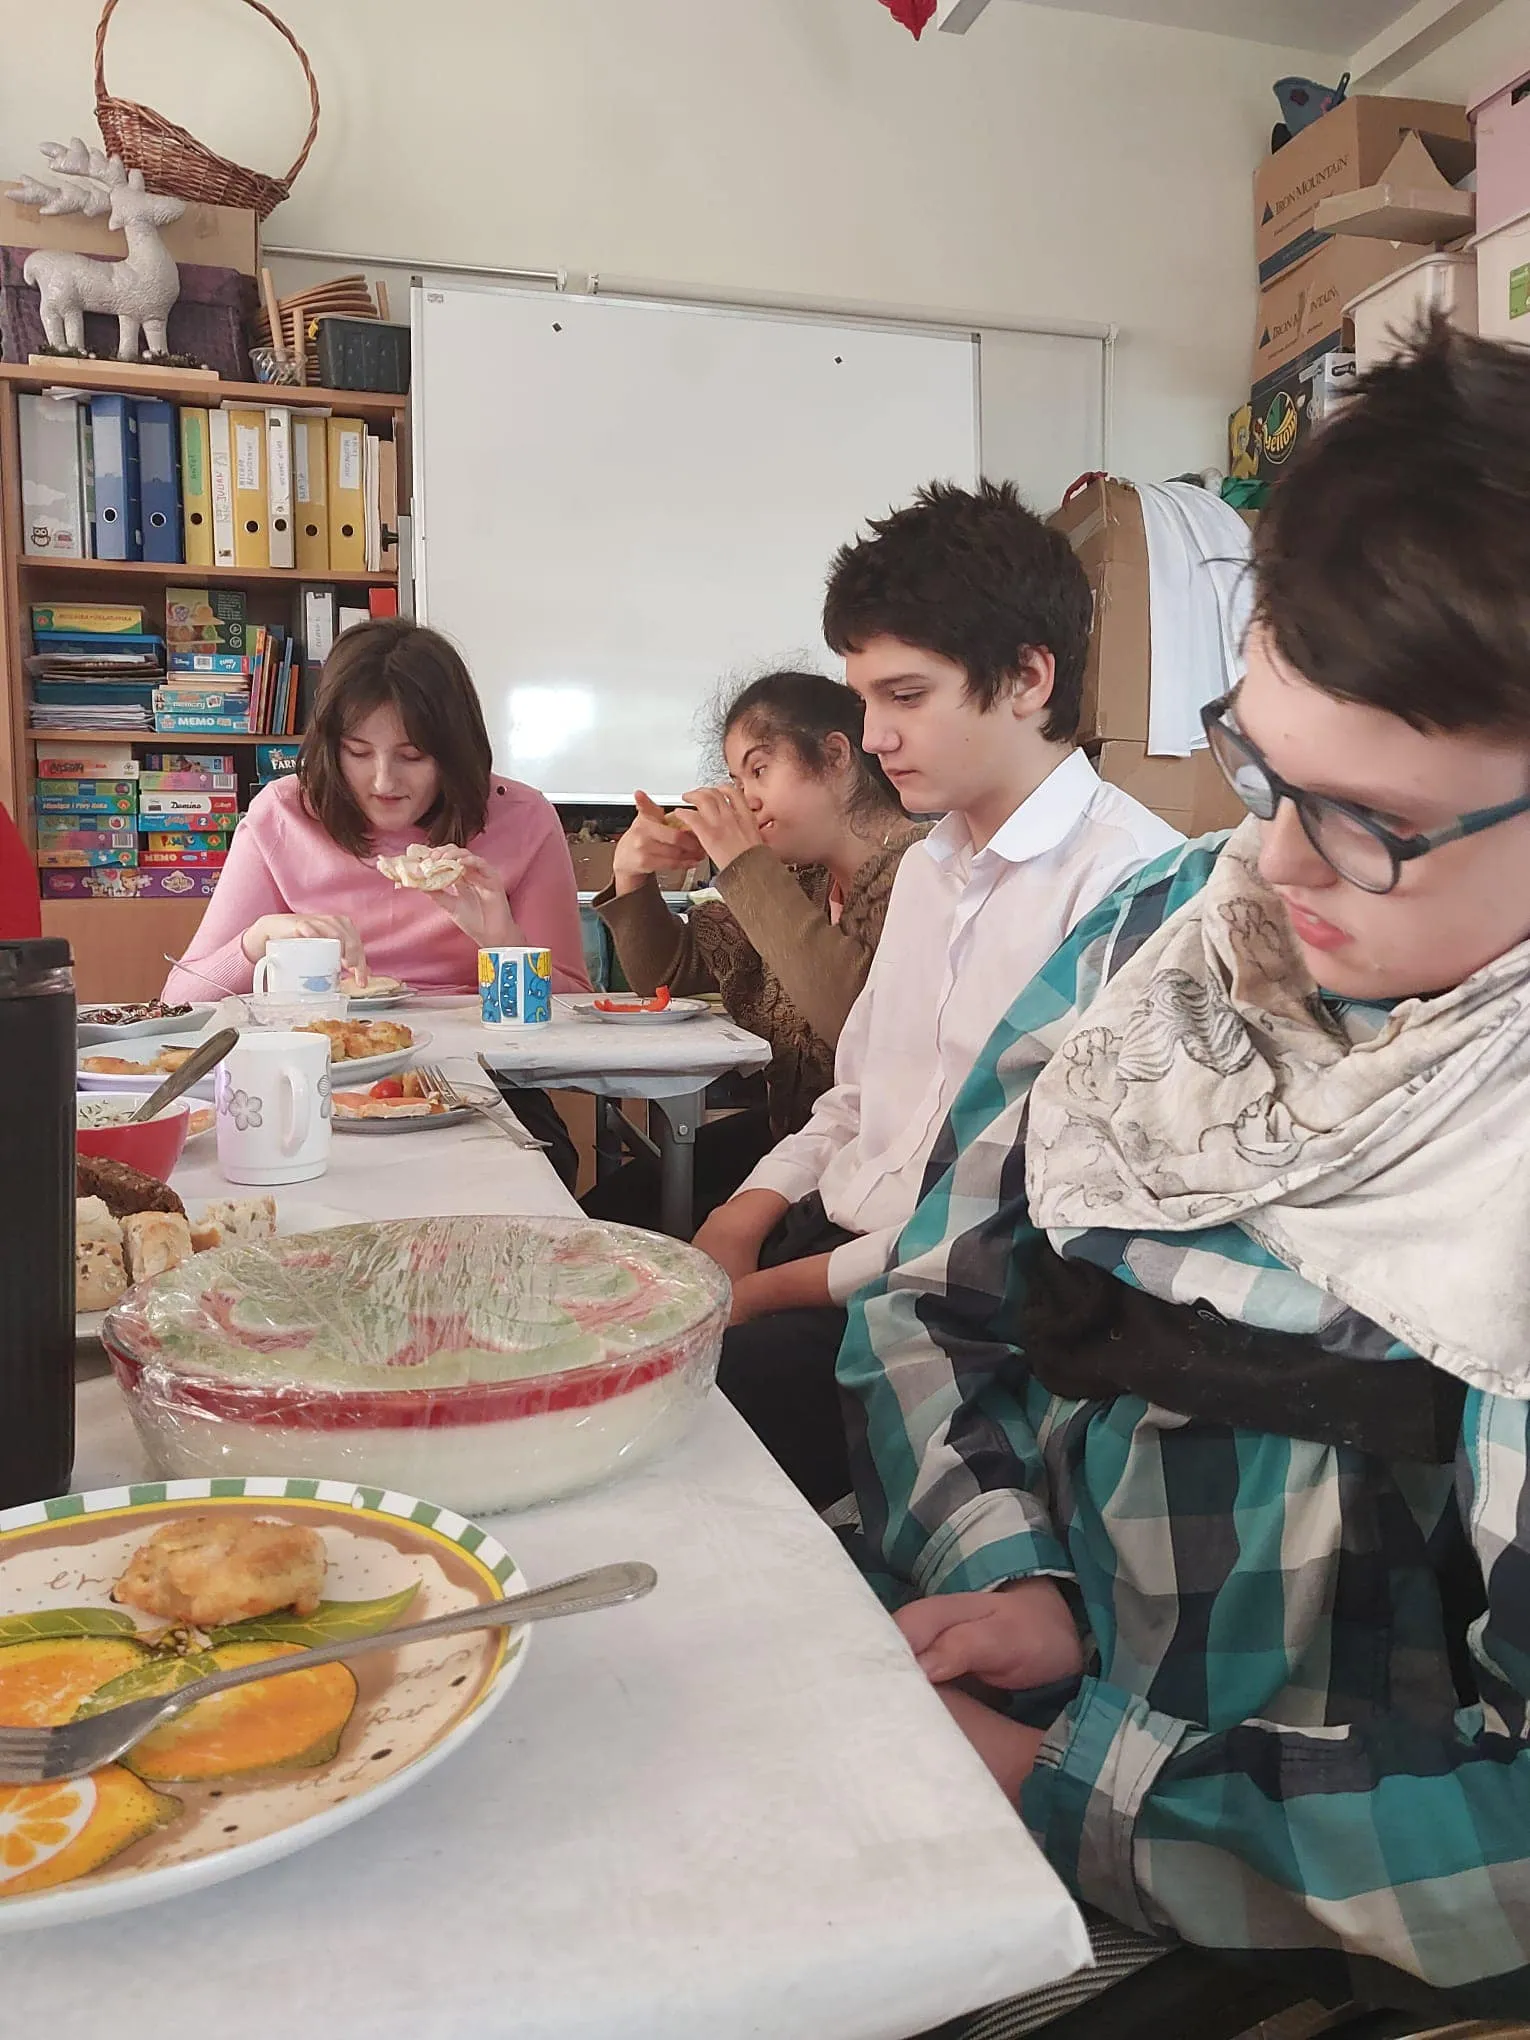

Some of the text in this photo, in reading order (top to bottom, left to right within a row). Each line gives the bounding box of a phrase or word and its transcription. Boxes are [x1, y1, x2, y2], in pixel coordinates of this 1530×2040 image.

[1296, 158, 1347, 198] MOUNTAIN
[178, 717, 215, 727] MEMO
[170, 801, 202, 809] Domino
[200, 817, 208, 826] 2
[144, 853, 178, 862] MEMO
